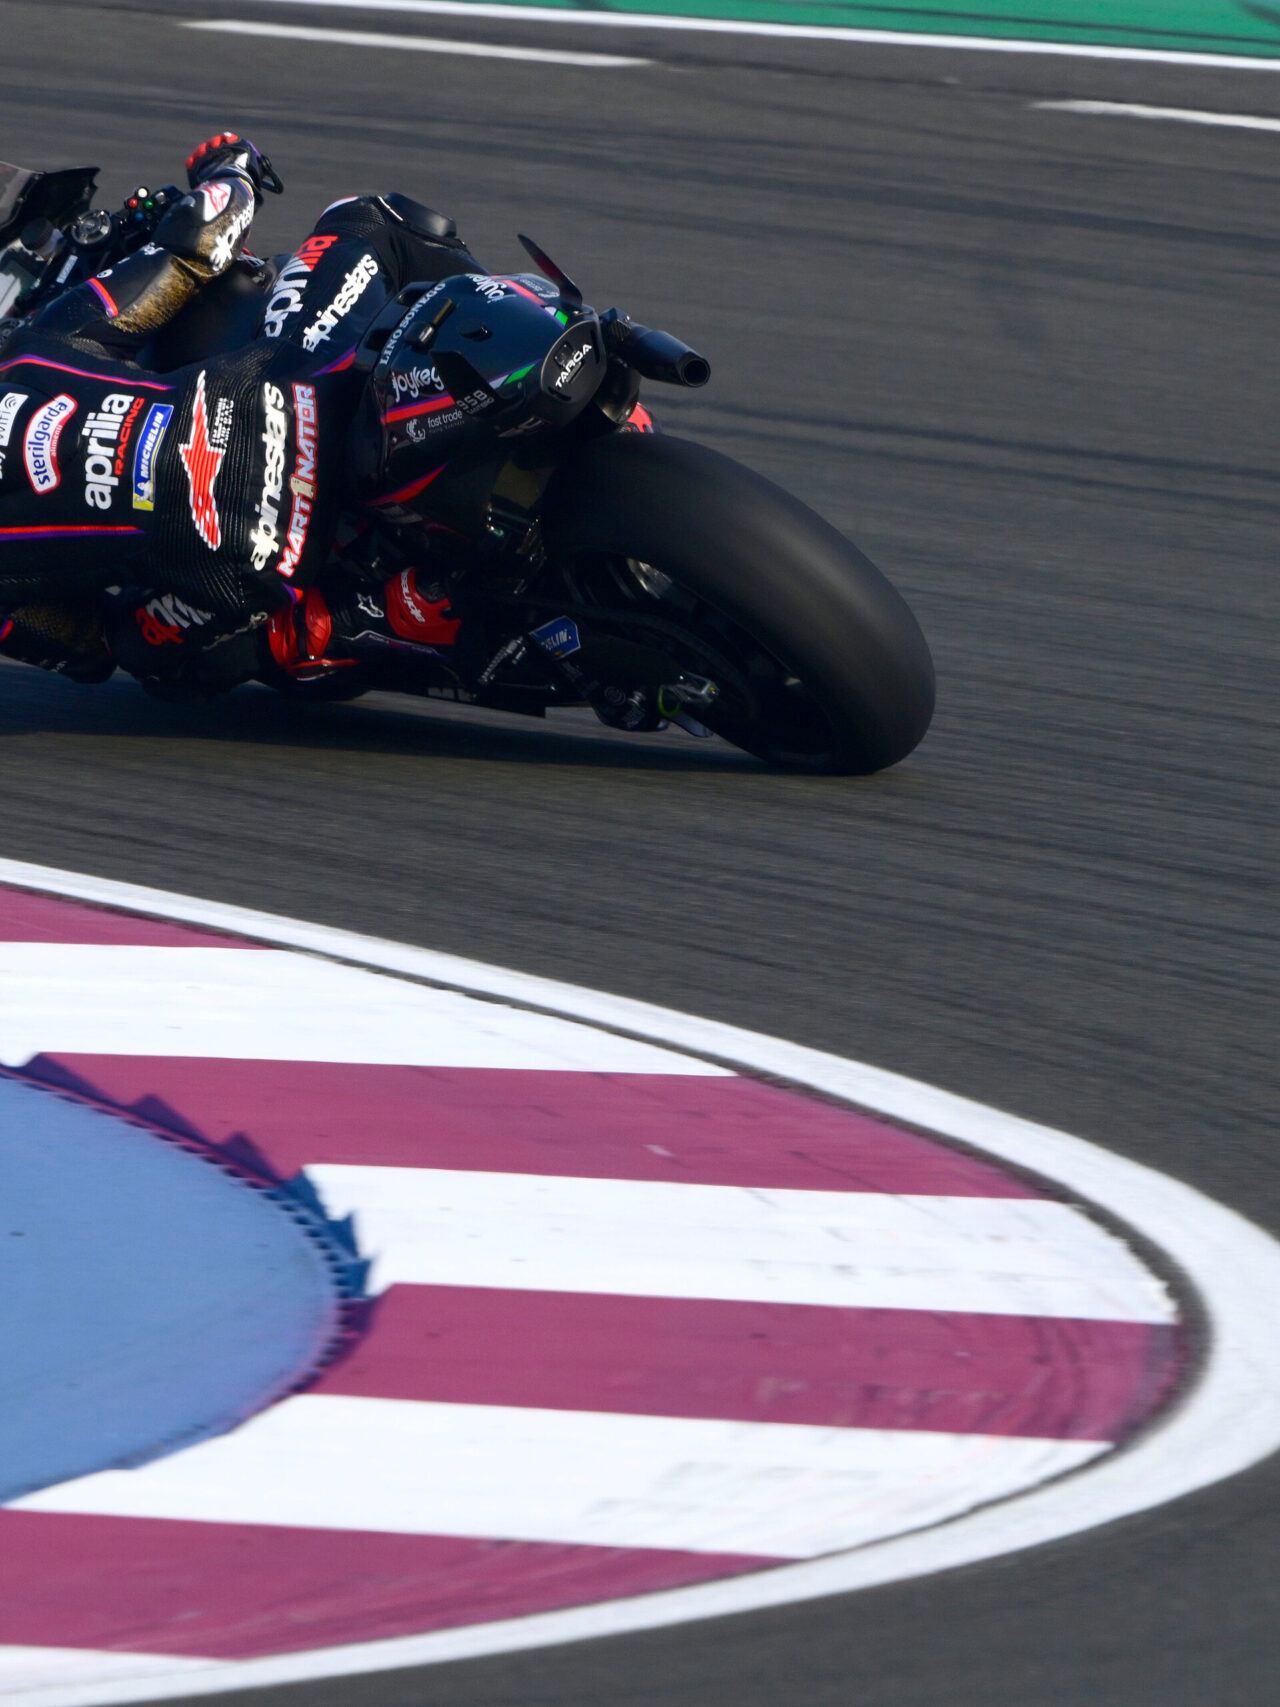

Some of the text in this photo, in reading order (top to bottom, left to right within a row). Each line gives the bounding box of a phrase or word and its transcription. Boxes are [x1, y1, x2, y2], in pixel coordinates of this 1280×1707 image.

[265, 235, 339, 338] aprilia
[302, 253, 379, 353] alpinestars
[378, 282, 447, 366] LINO SONEGO
[391, 365, 446, 403] joykey
[456, 389, 489, 411] 958
[554, 343, 593, 389] TARGA
[28, 401, 69, 486] sterilgarda
[83, 393, 135, 511] aprilia
[114, 396, 147, 477] RACING
[140, 411, 166, 479] MICHELIN
[427, 414, 443, 431] fast
[249, 381, 287, 572] alpinestars
[276, 382, 318, 579] MART1NATOR
